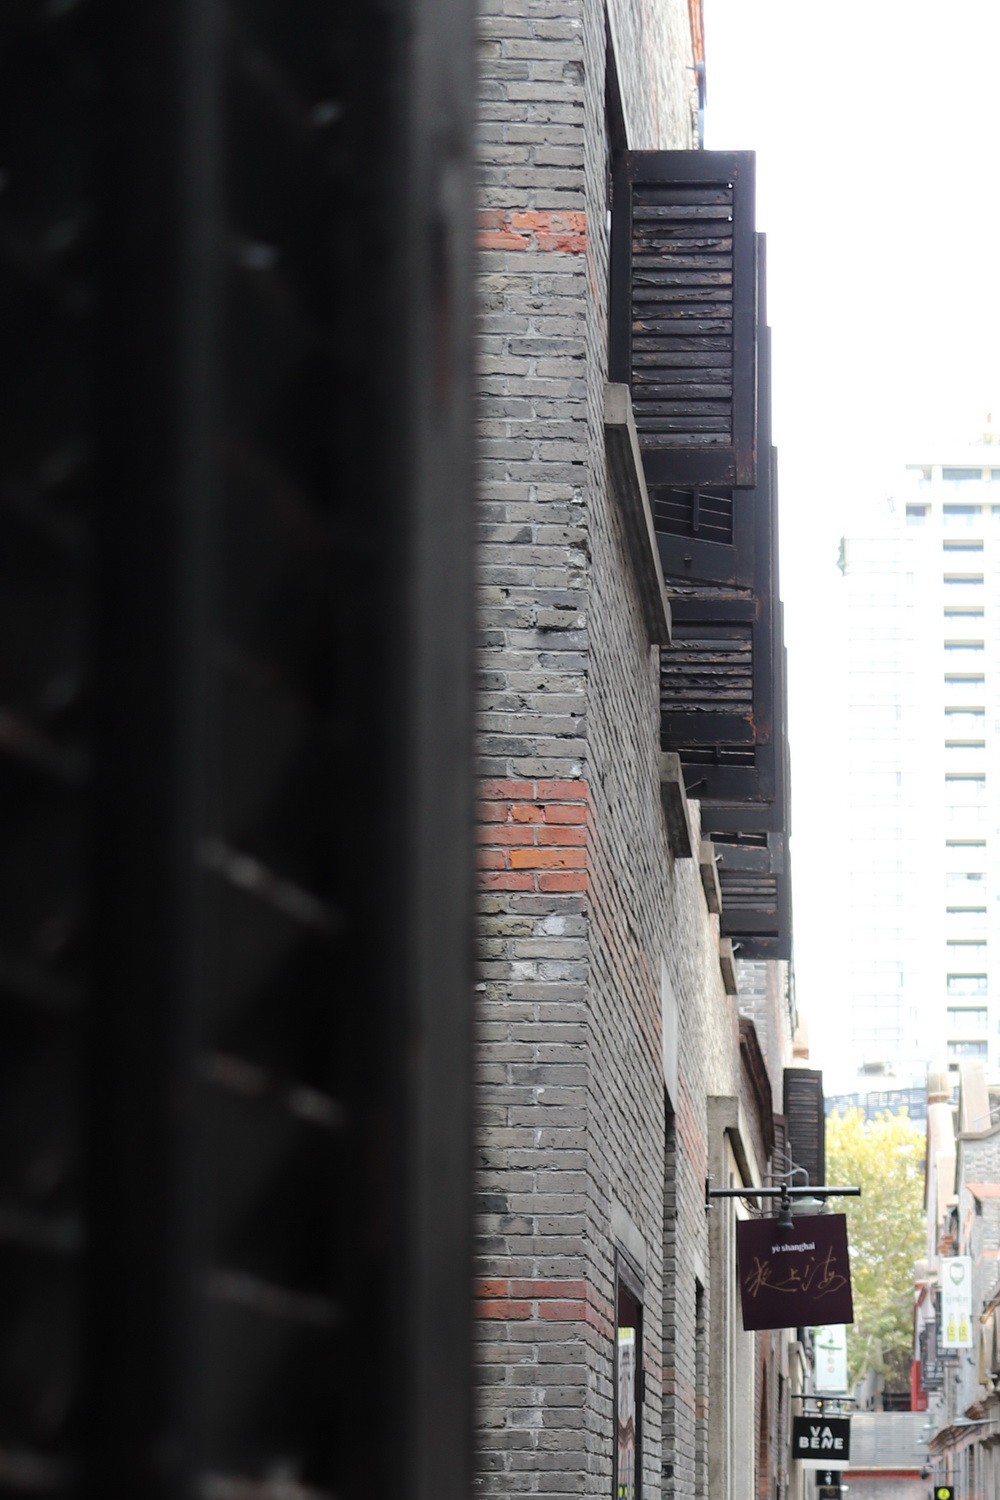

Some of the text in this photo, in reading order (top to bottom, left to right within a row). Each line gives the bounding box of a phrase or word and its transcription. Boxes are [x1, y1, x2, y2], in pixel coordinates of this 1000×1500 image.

[781, 1242, 816, 1252] shanghai
[810, 1425, 833, 1438] VA
[798, 1436, 844, 1450] BENE
